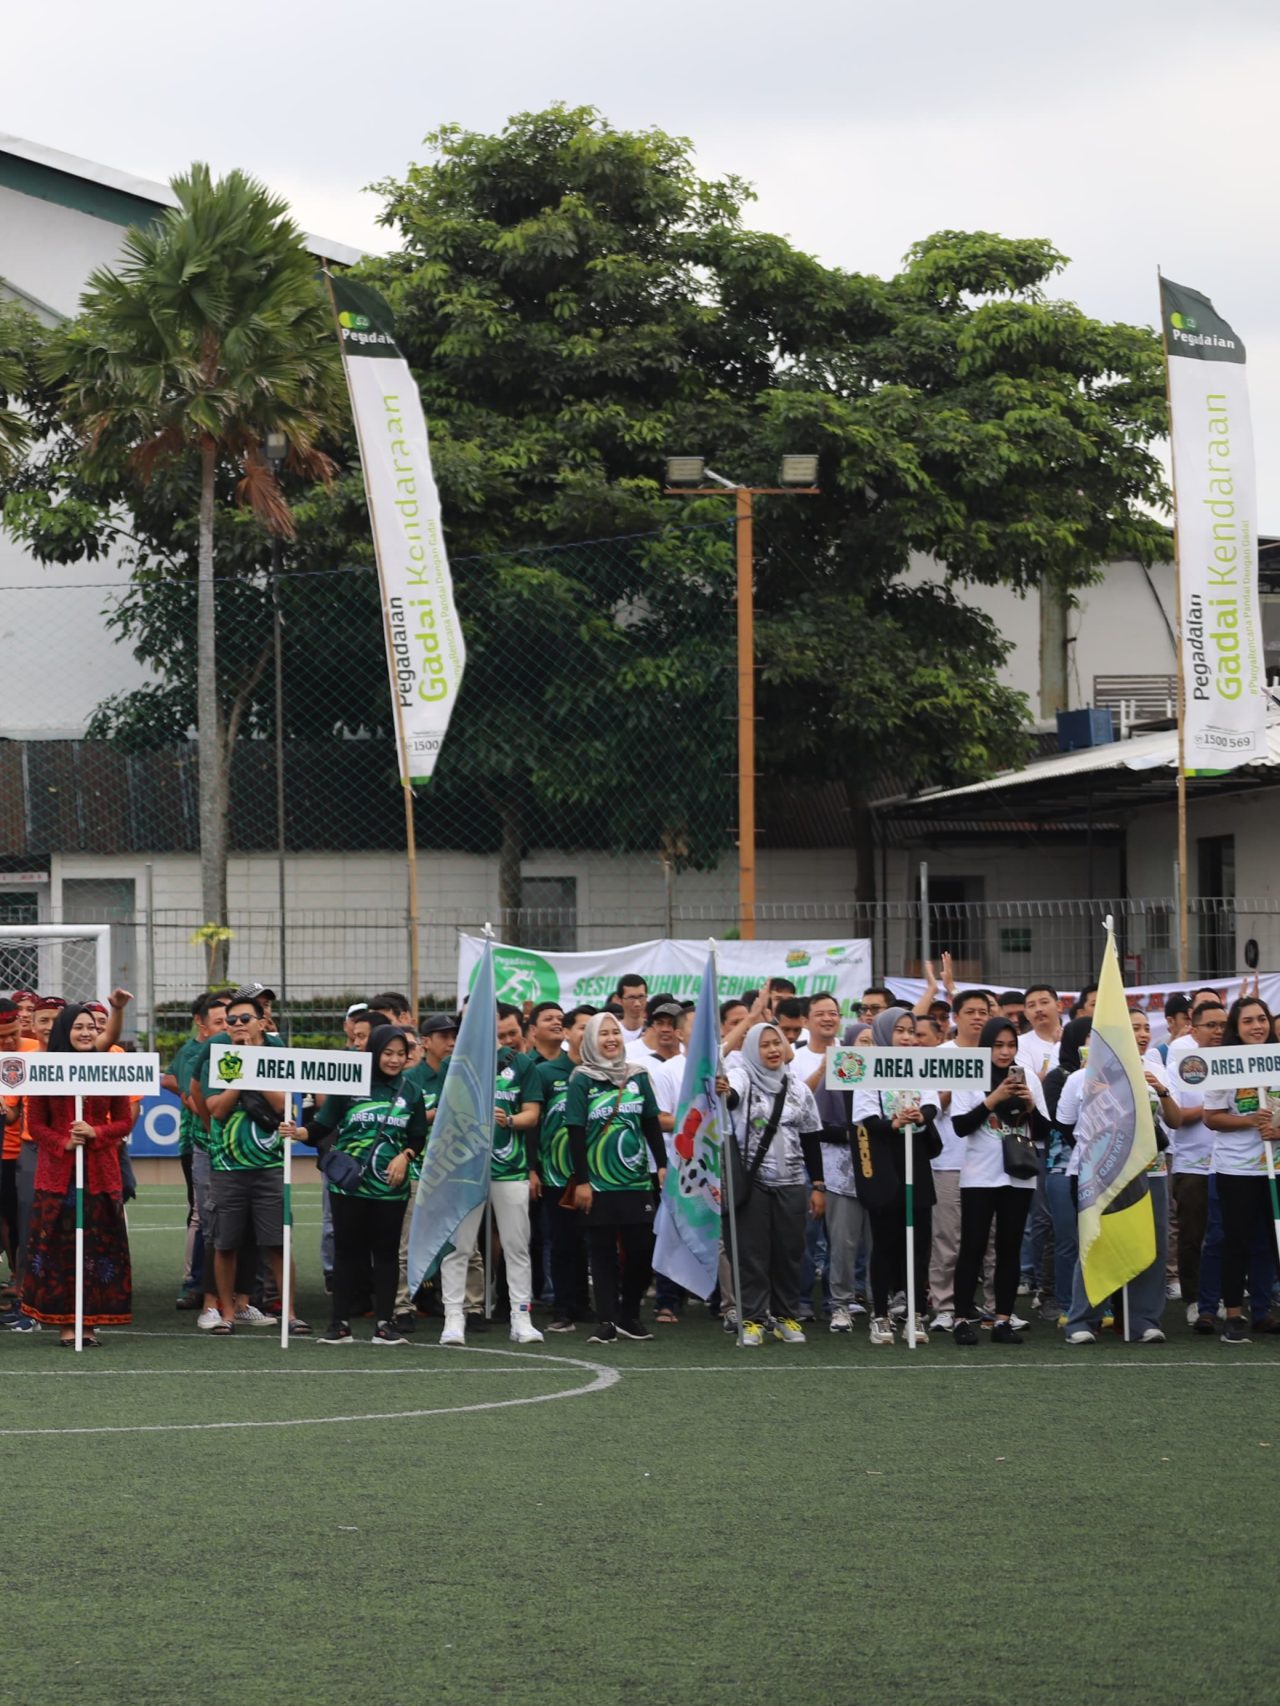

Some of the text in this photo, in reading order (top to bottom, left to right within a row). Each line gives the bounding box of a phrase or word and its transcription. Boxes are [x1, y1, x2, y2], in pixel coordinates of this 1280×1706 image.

[383, 395, 429, 586] Kendaraan
[1203, 394, 1238, 585] Kendaraan
[390, 597, 416, 707] Pegadaian
[409, 599, 448, 702] Gadai
[1186, 594, 1212, 700] Pegadaian
[1209, 599, 1243, 700] Gadai
[413, 740, 439, 751] 1500
[1204, 734, 1250, 748] 1500 569
[573, 975, 704, 996] SESUUHNYA
[812, 975, 838, 995] ITU
[29, 1065, 153, 1082] AREA PAMEKASAN
[256, 1058, 362, 1083] AREA MADIUN
[873, 1058, 984, 1078] AREA JEMBER
[1211, 1055, 1280, 1076] AREA PROB
